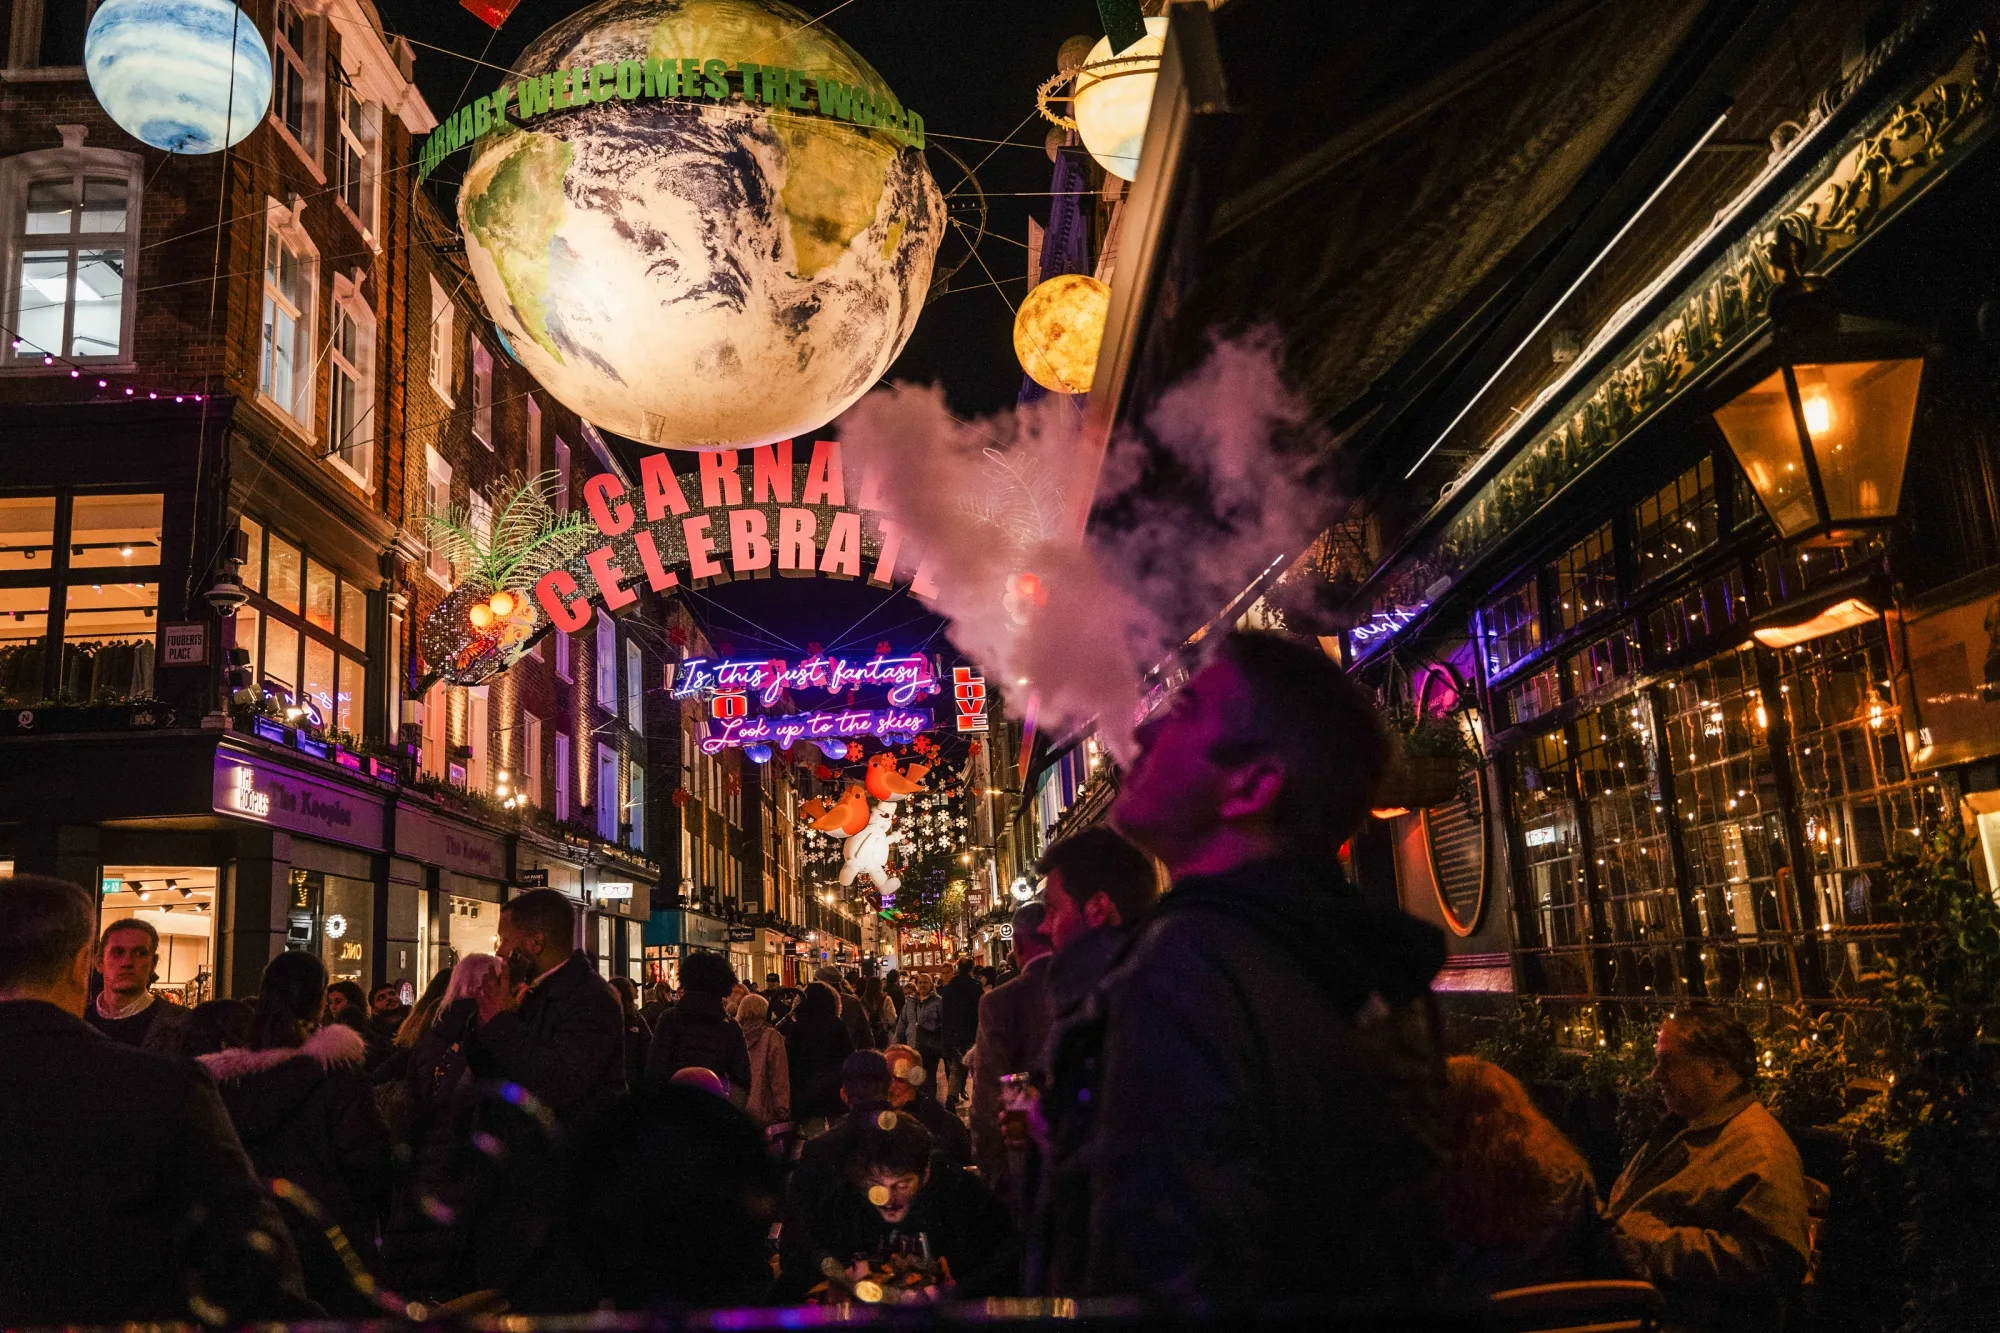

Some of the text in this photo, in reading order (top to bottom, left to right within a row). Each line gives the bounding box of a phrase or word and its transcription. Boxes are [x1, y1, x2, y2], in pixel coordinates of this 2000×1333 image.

[419, 58, 926, 186] CARNABY WELCOMES THE WORLD
[169, 648, 192, 660] PLACE
[673, 655, 933, 702] Is this just fantasy
[952, 666, 989, 732] LOVE
[702, 710, 924, 751] Look up to the skies
[239, 767, 254, 788] THE
[239, 787, 269, 815] KOOPLES
[270, 780, 297, 812] The
